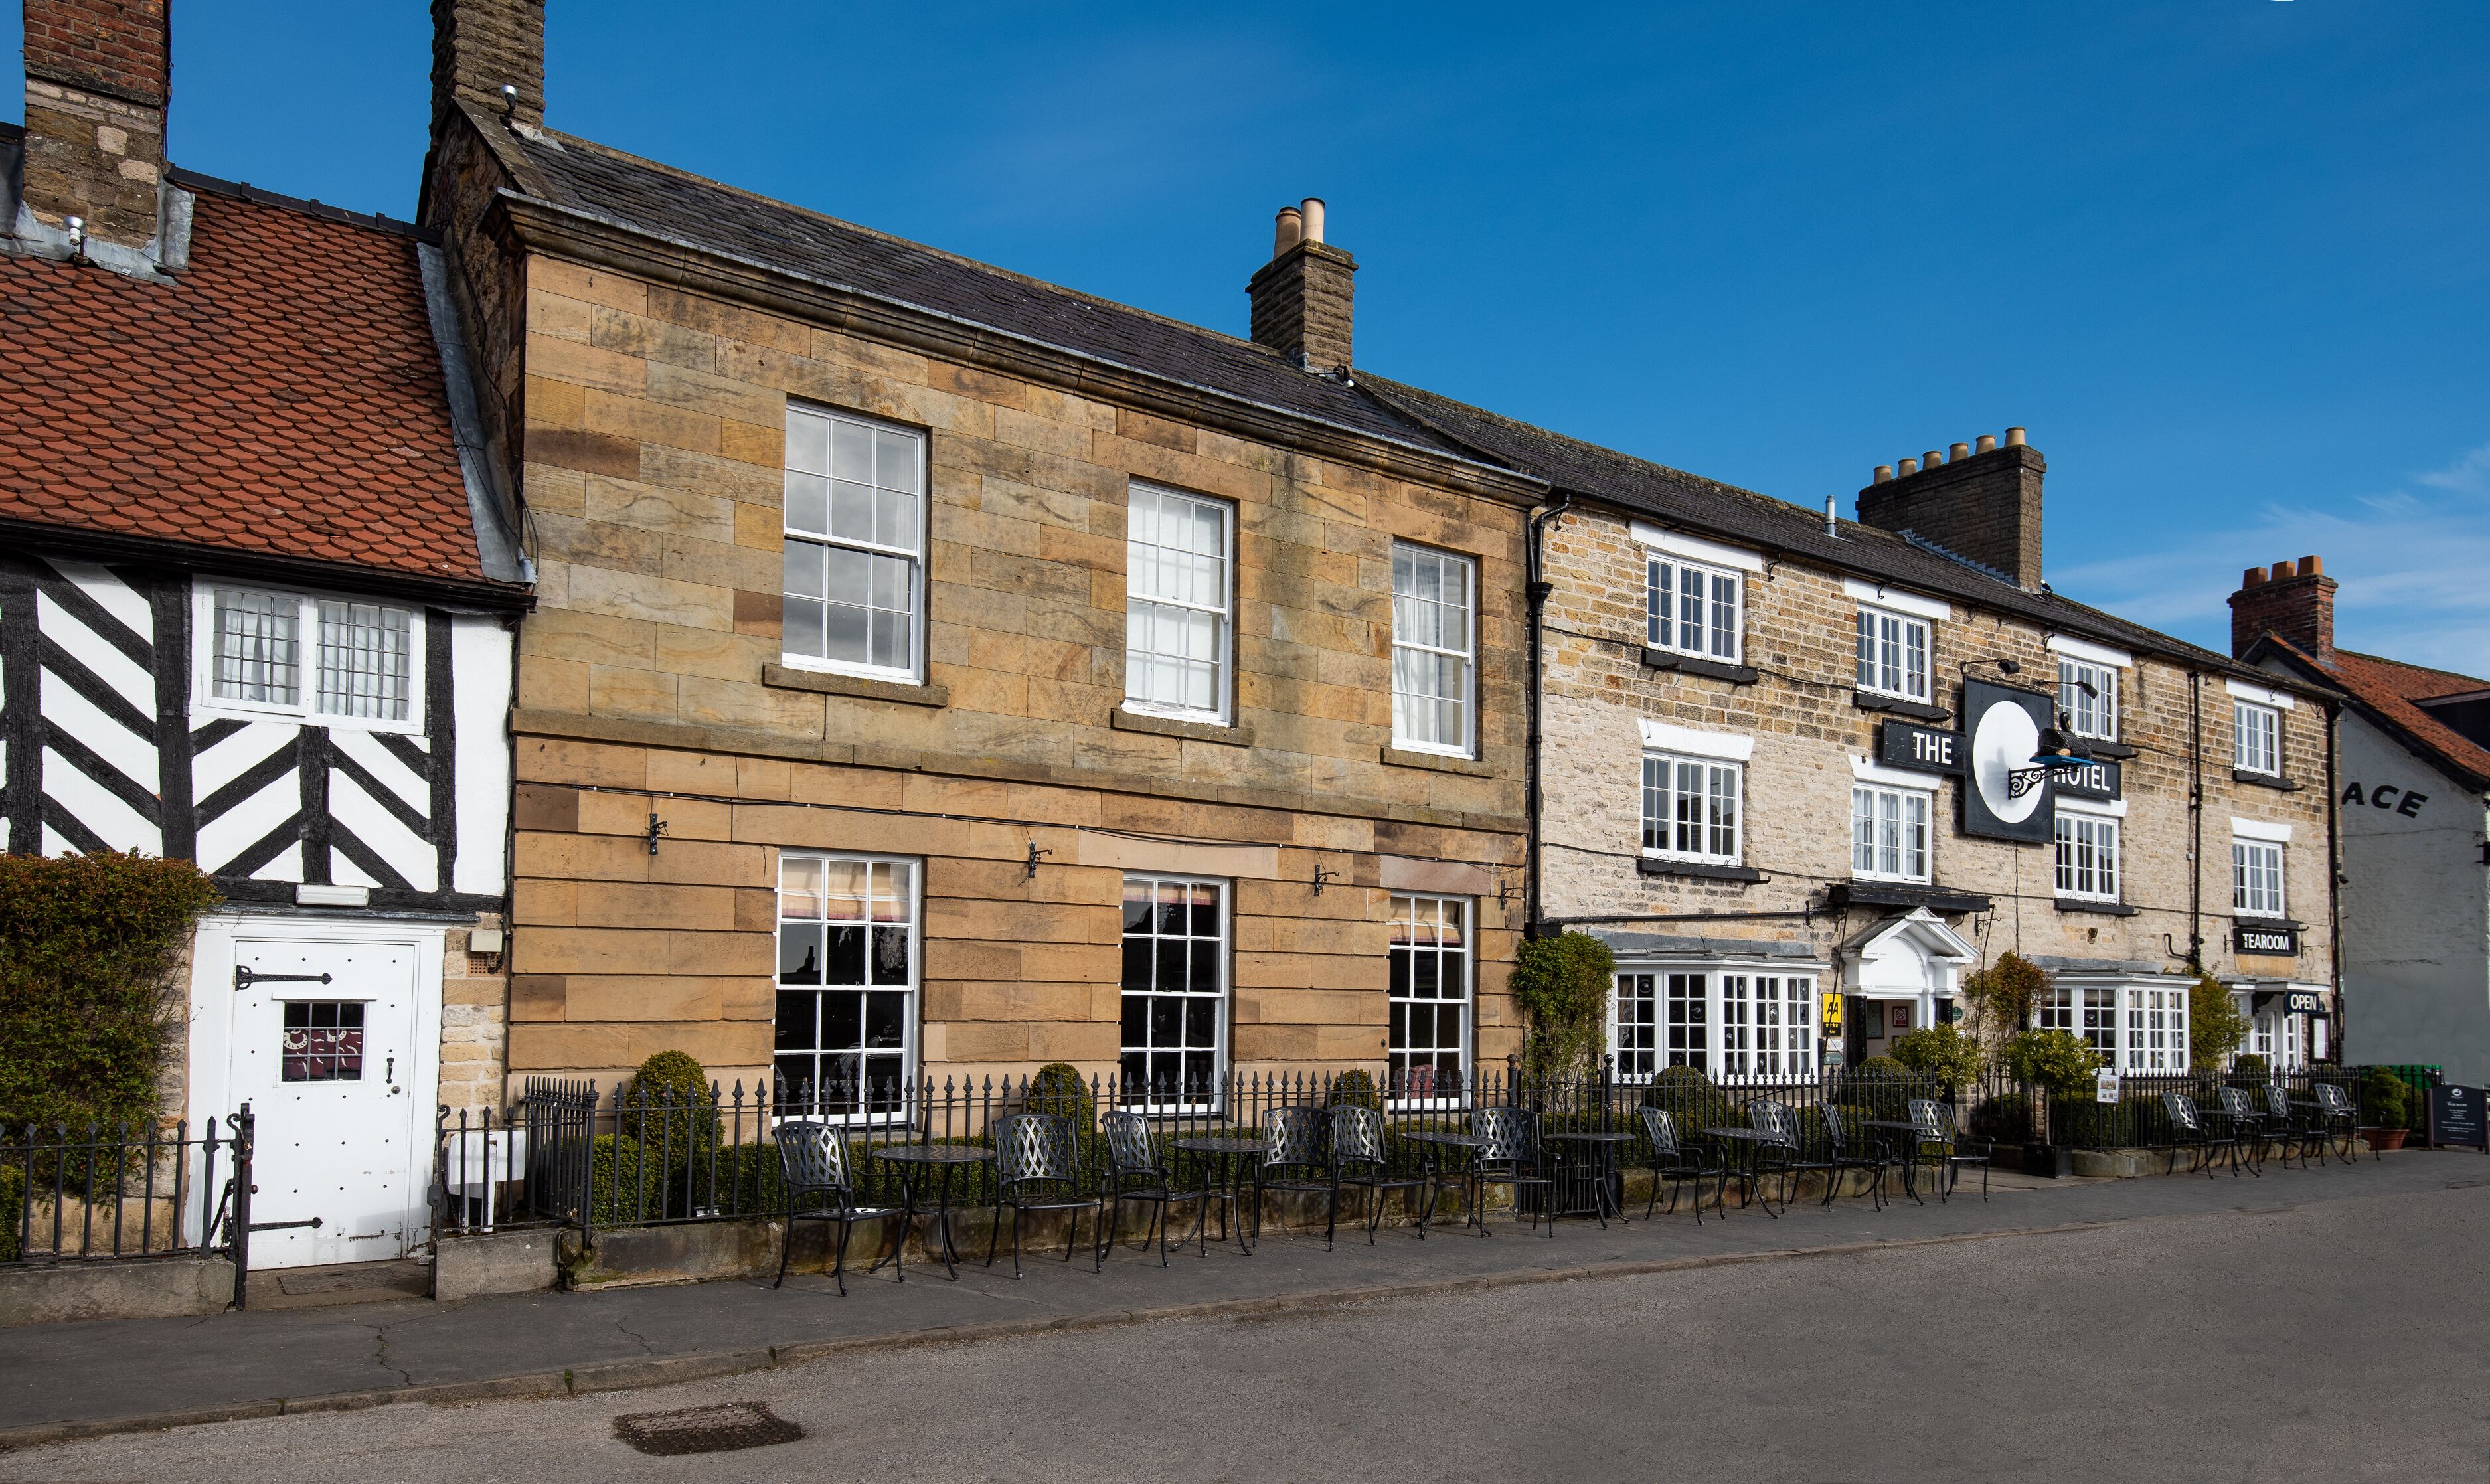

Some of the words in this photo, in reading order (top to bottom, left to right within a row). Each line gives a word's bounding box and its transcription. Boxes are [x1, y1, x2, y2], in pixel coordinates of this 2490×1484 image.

[1912, 732, 1952, 764] THE
[2242, 933, 2289, 951] TEAROOM
[1827, 1002, 1839, 1014] AA
[2291, 994, 2317, 1011] OPEN
